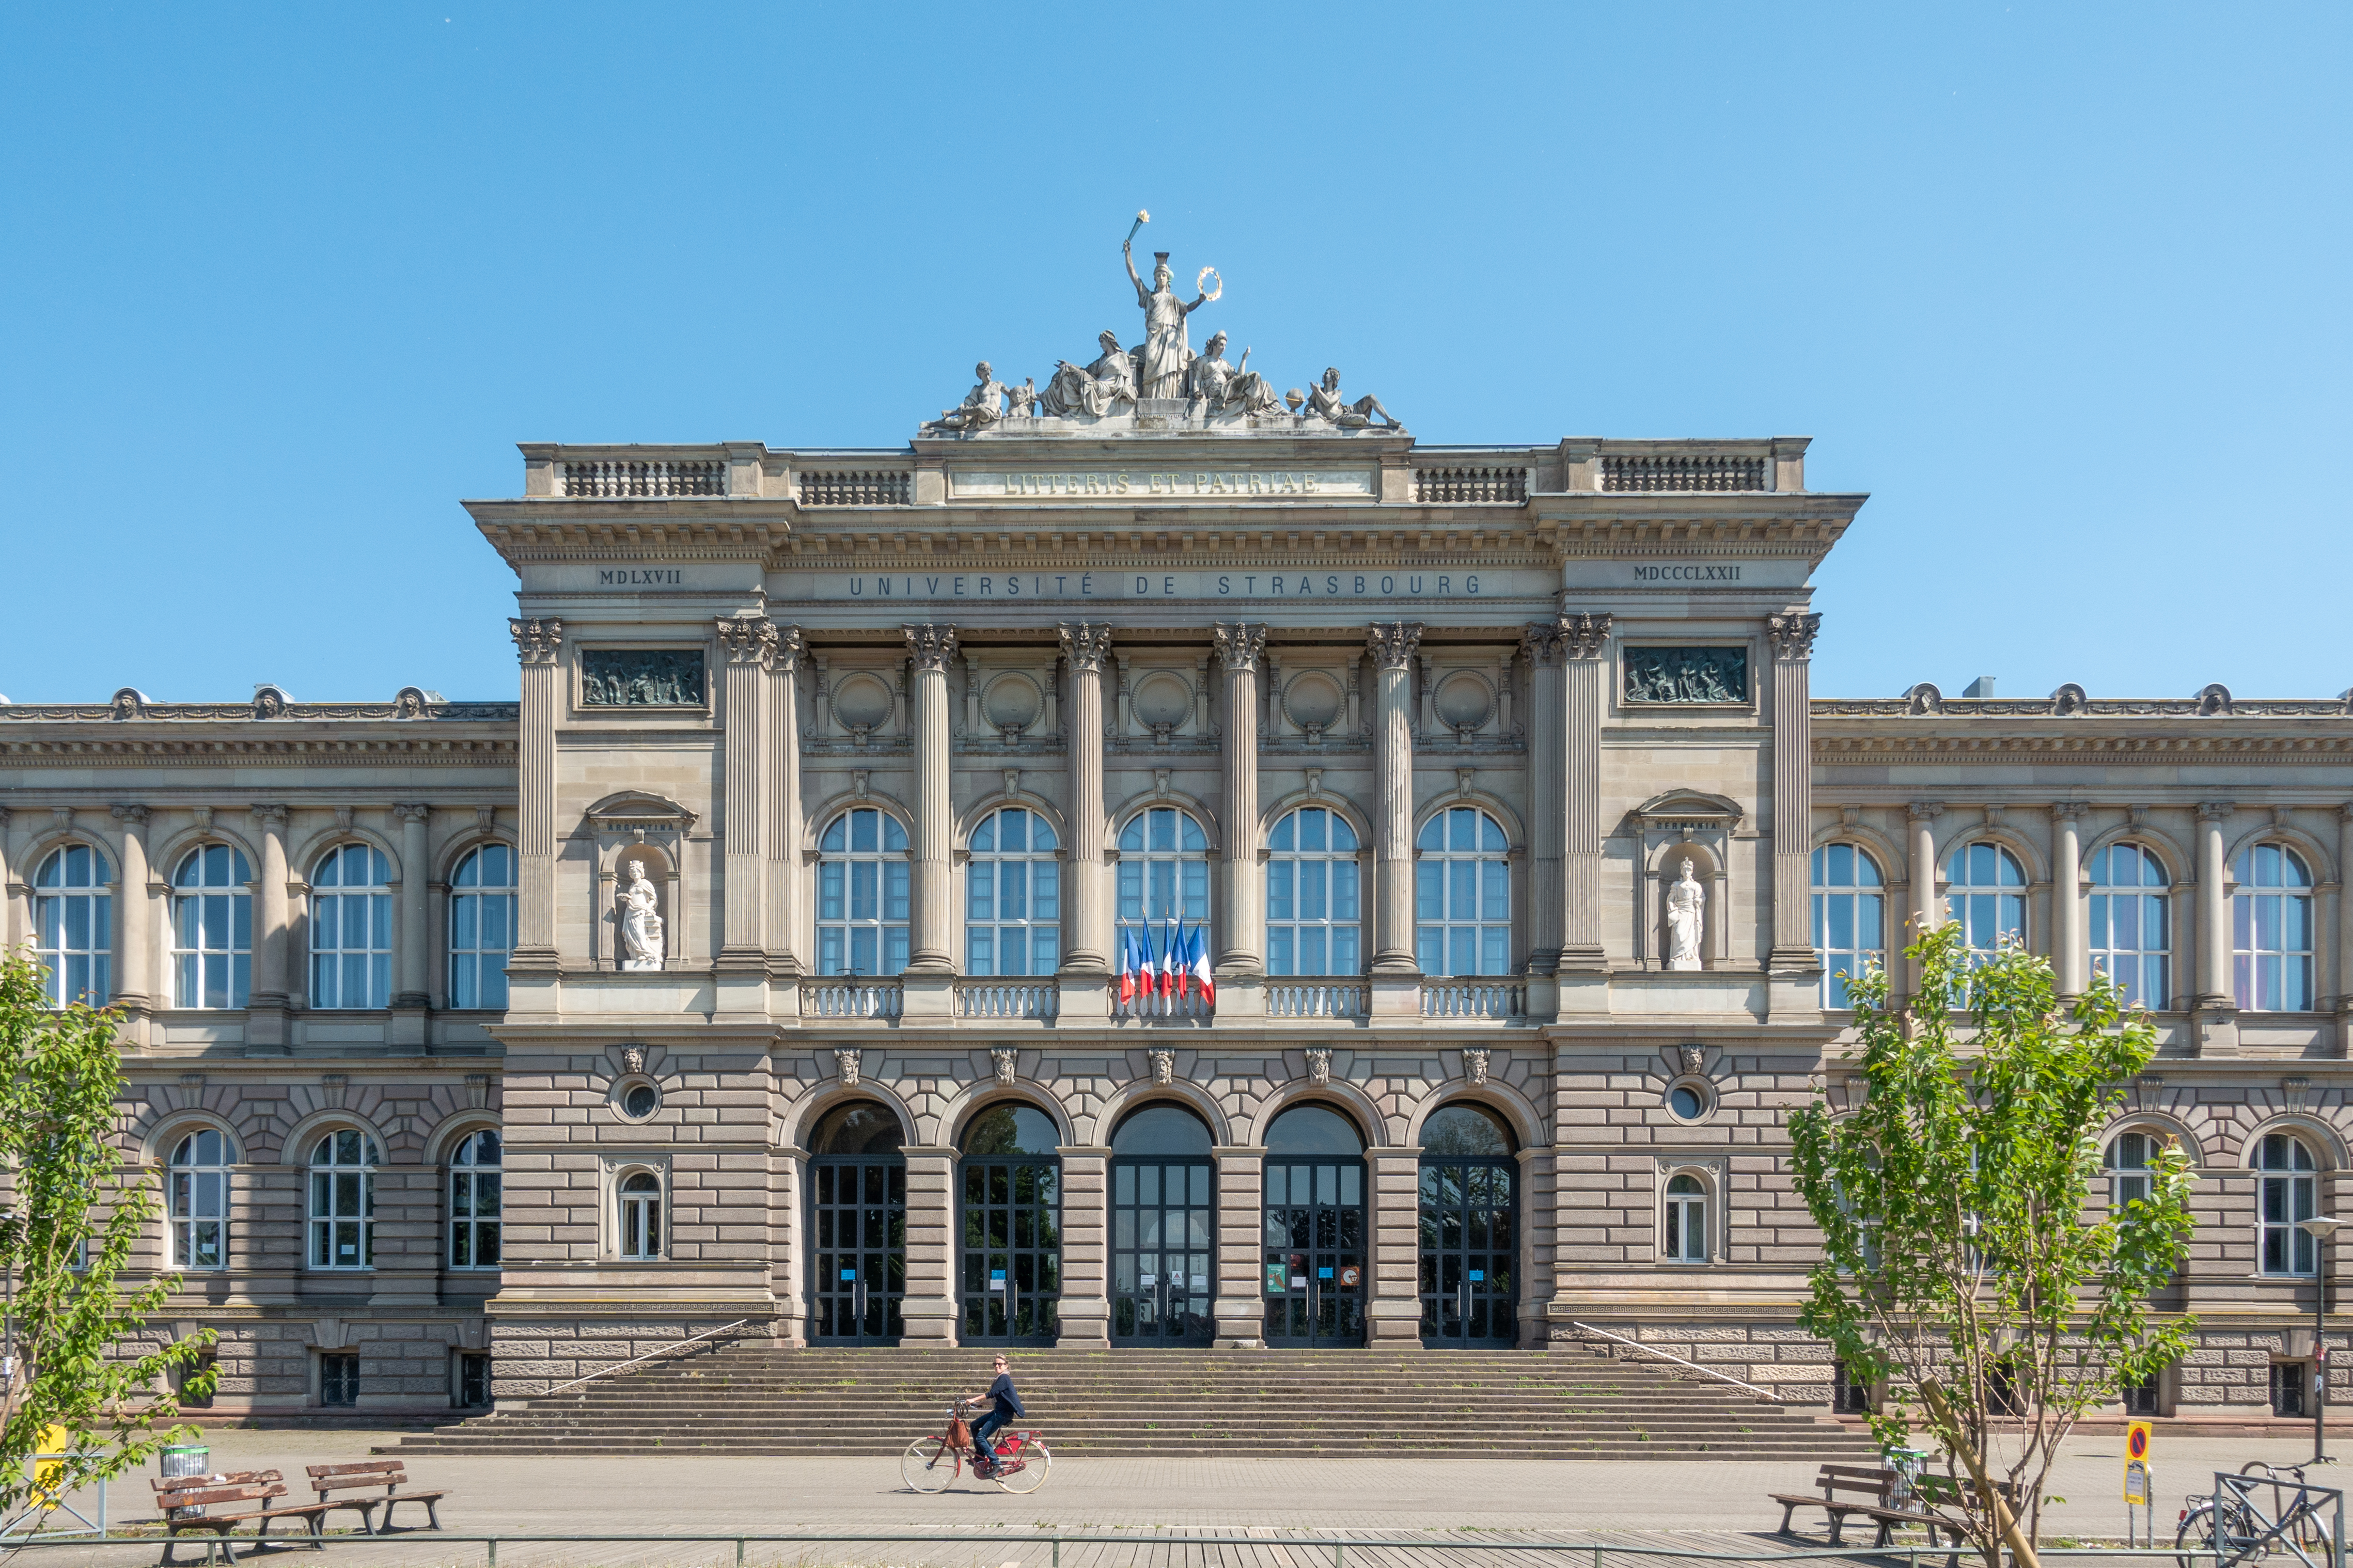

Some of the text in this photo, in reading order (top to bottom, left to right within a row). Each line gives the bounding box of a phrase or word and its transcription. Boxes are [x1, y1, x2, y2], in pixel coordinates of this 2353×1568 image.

[1005, 474, 1130, 493] LITTERIS
[1149, 474, 1180, 493] ET
[600, 570, 681, 584] MDLXVII
[1634, 566, 1740, 580] MDCCCLXXII
[850, 572, 1480, 595] UNIVERSITÉ DE STRASBOURG
